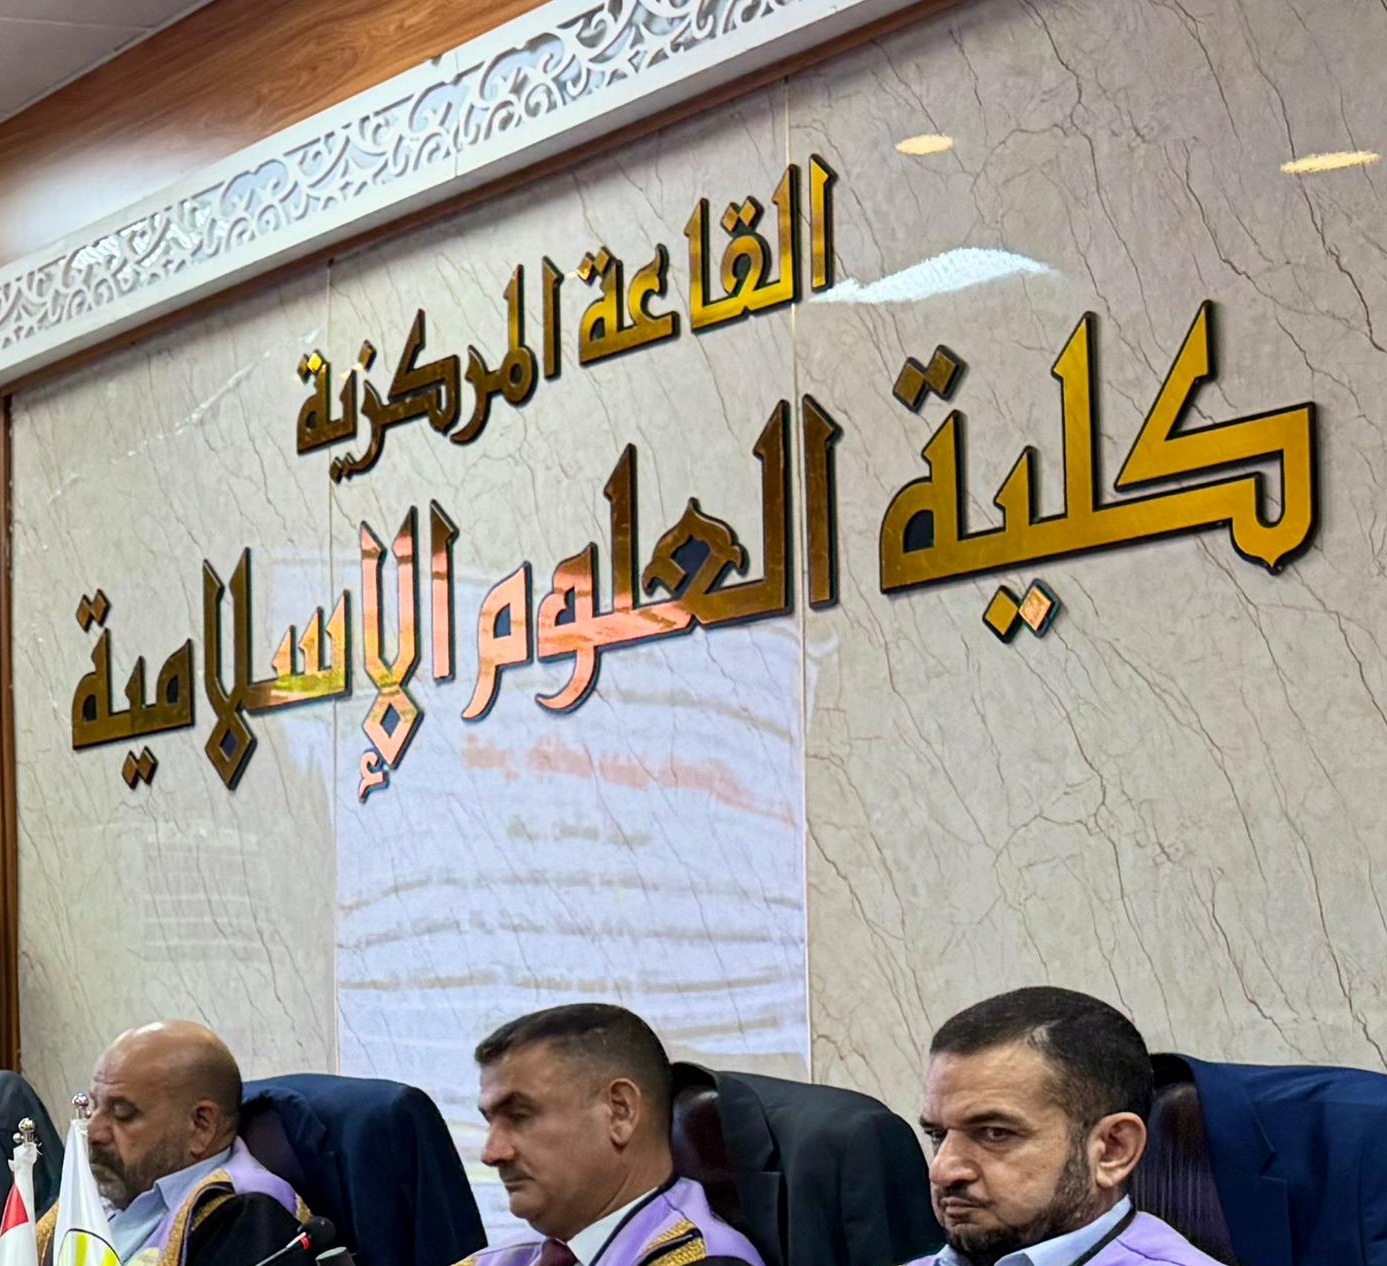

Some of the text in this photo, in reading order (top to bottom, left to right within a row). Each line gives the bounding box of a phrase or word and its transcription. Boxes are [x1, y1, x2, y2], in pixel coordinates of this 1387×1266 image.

[293, 153, 840, 480] القاعة المركزية
[69, 297, 1321, 801] كلية العلوم الإسلامية
